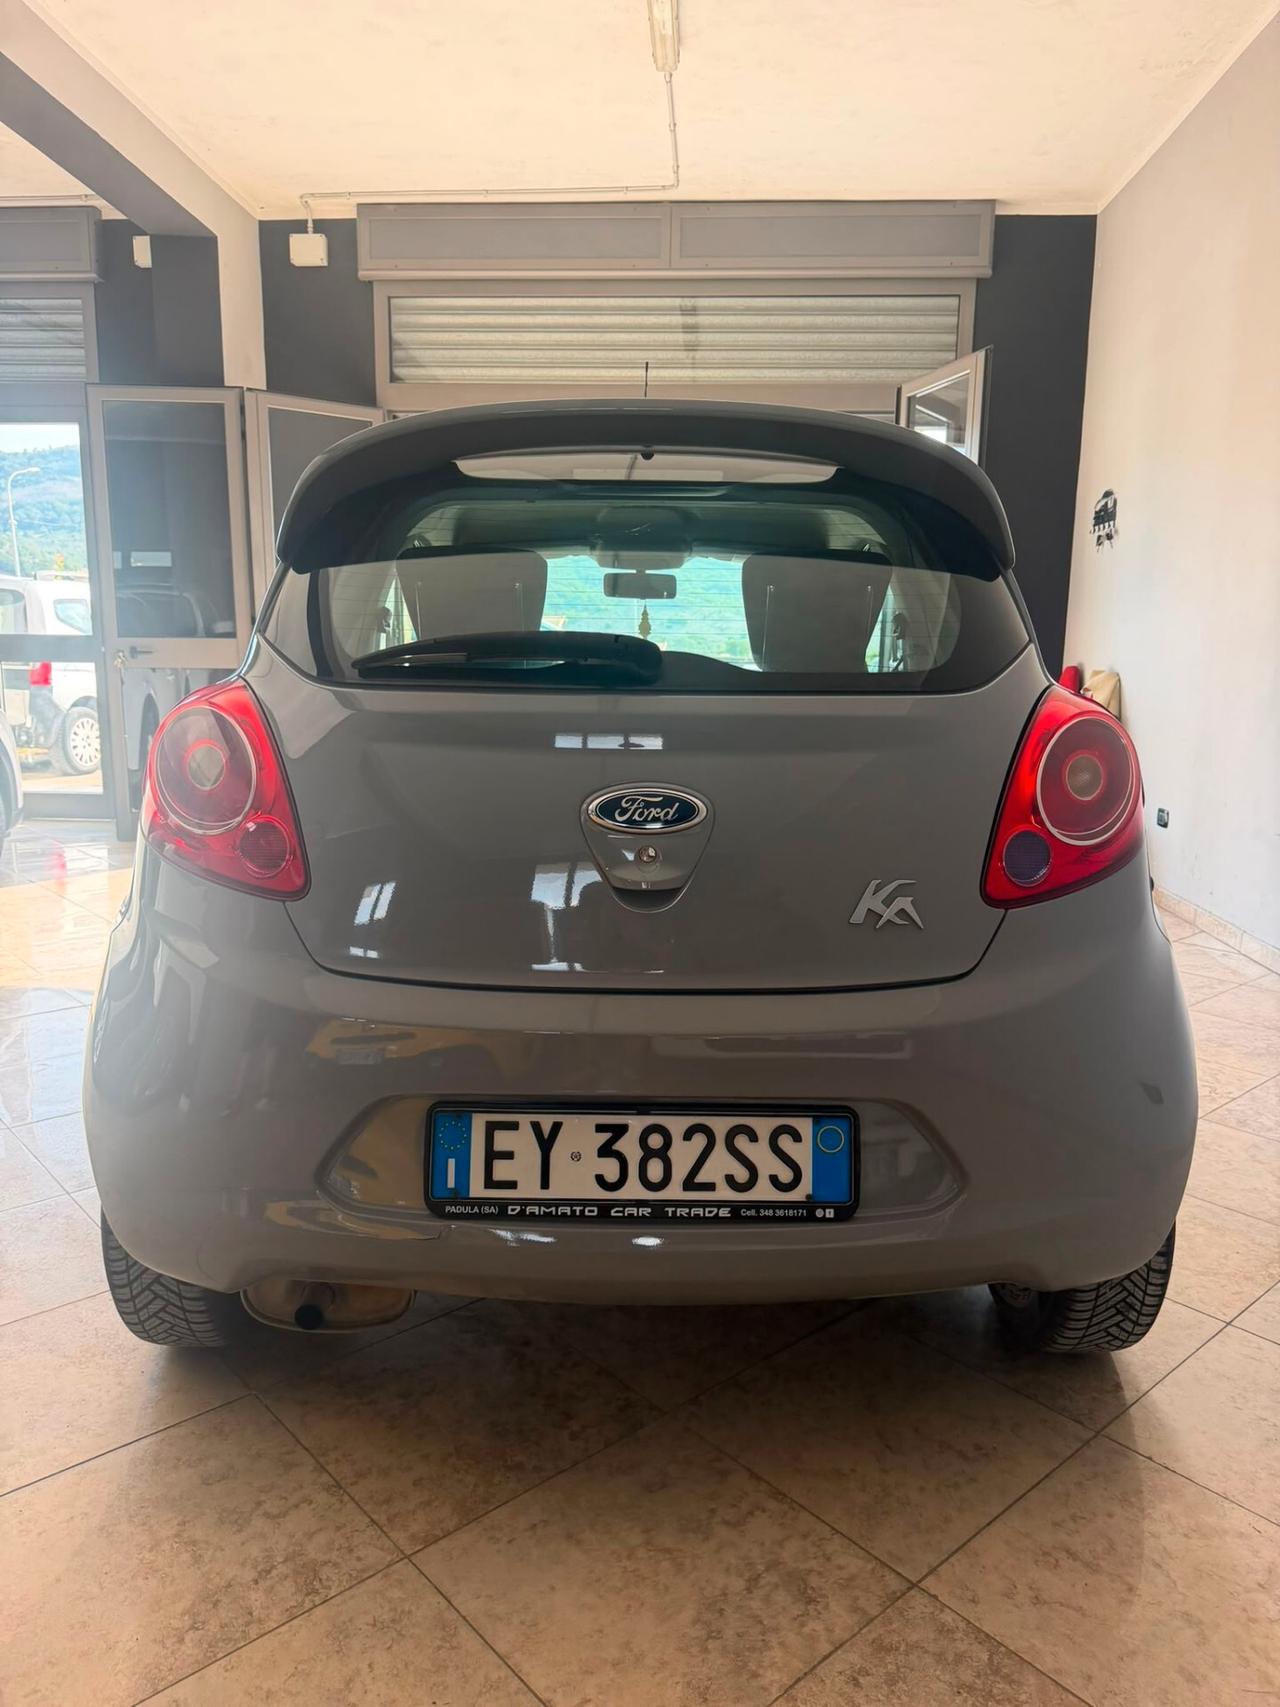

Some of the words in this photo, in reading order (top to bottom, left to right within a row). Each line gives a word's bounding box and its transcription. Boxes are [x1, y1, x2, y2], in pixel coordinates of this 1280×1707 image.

[614, 796, 679, 822] Ford
[484, 1121, 563, 1190] EY
[595, 1123, 803, 1193] 382SS
[445, 1205, 479, 1214] PADULA
[481, 1205, 499, 1215] (SA)
[507, 1205, 599, 1216] D'AMATO
[610, 1207, 652, 1217] CAR
[664, 1207, 731, 1217] TRADE
[740, 1208, 758, 1217] Cell.
[759, 1208, 774, 1217] 348
